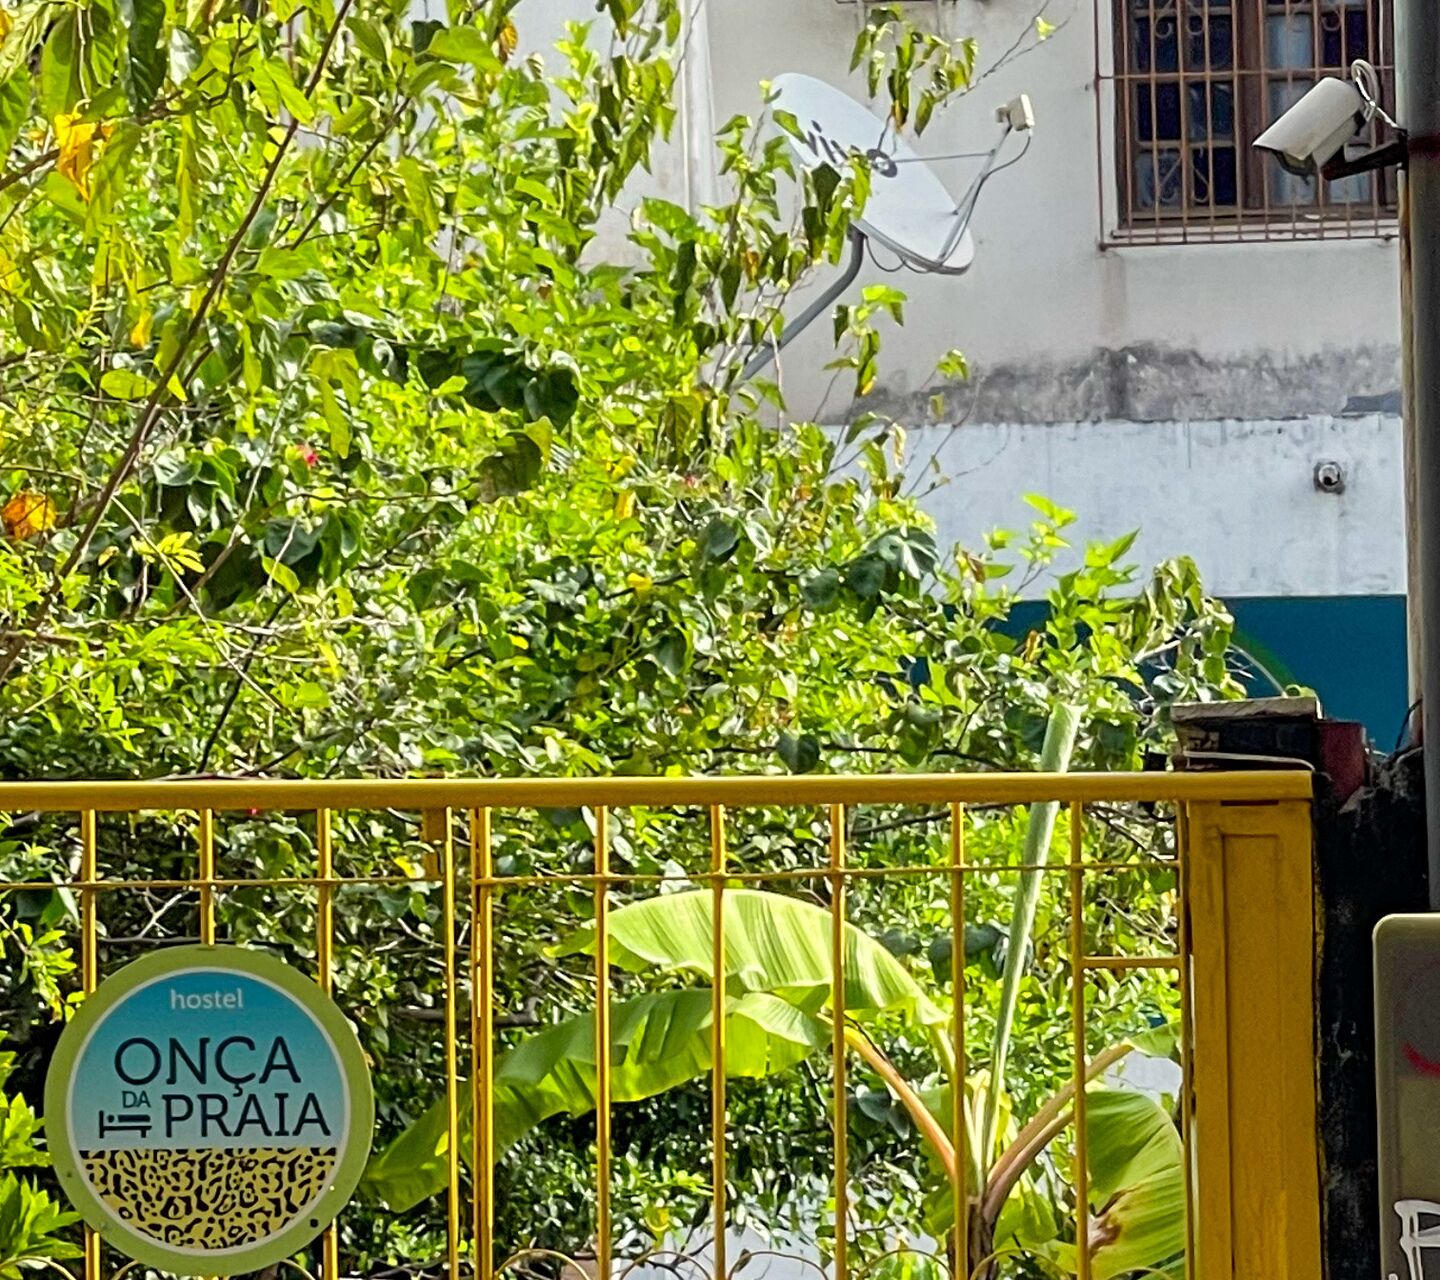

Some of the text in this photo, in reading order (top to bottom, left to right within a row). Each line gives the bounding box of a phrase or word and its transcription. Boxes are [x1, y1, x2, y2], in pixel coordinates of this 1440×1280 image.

[170, 988, 244, 1010] hostel
[113, 1035, 302, 1097] ONÇA
[121, 1090, 332, 1138] DA PRAIA
